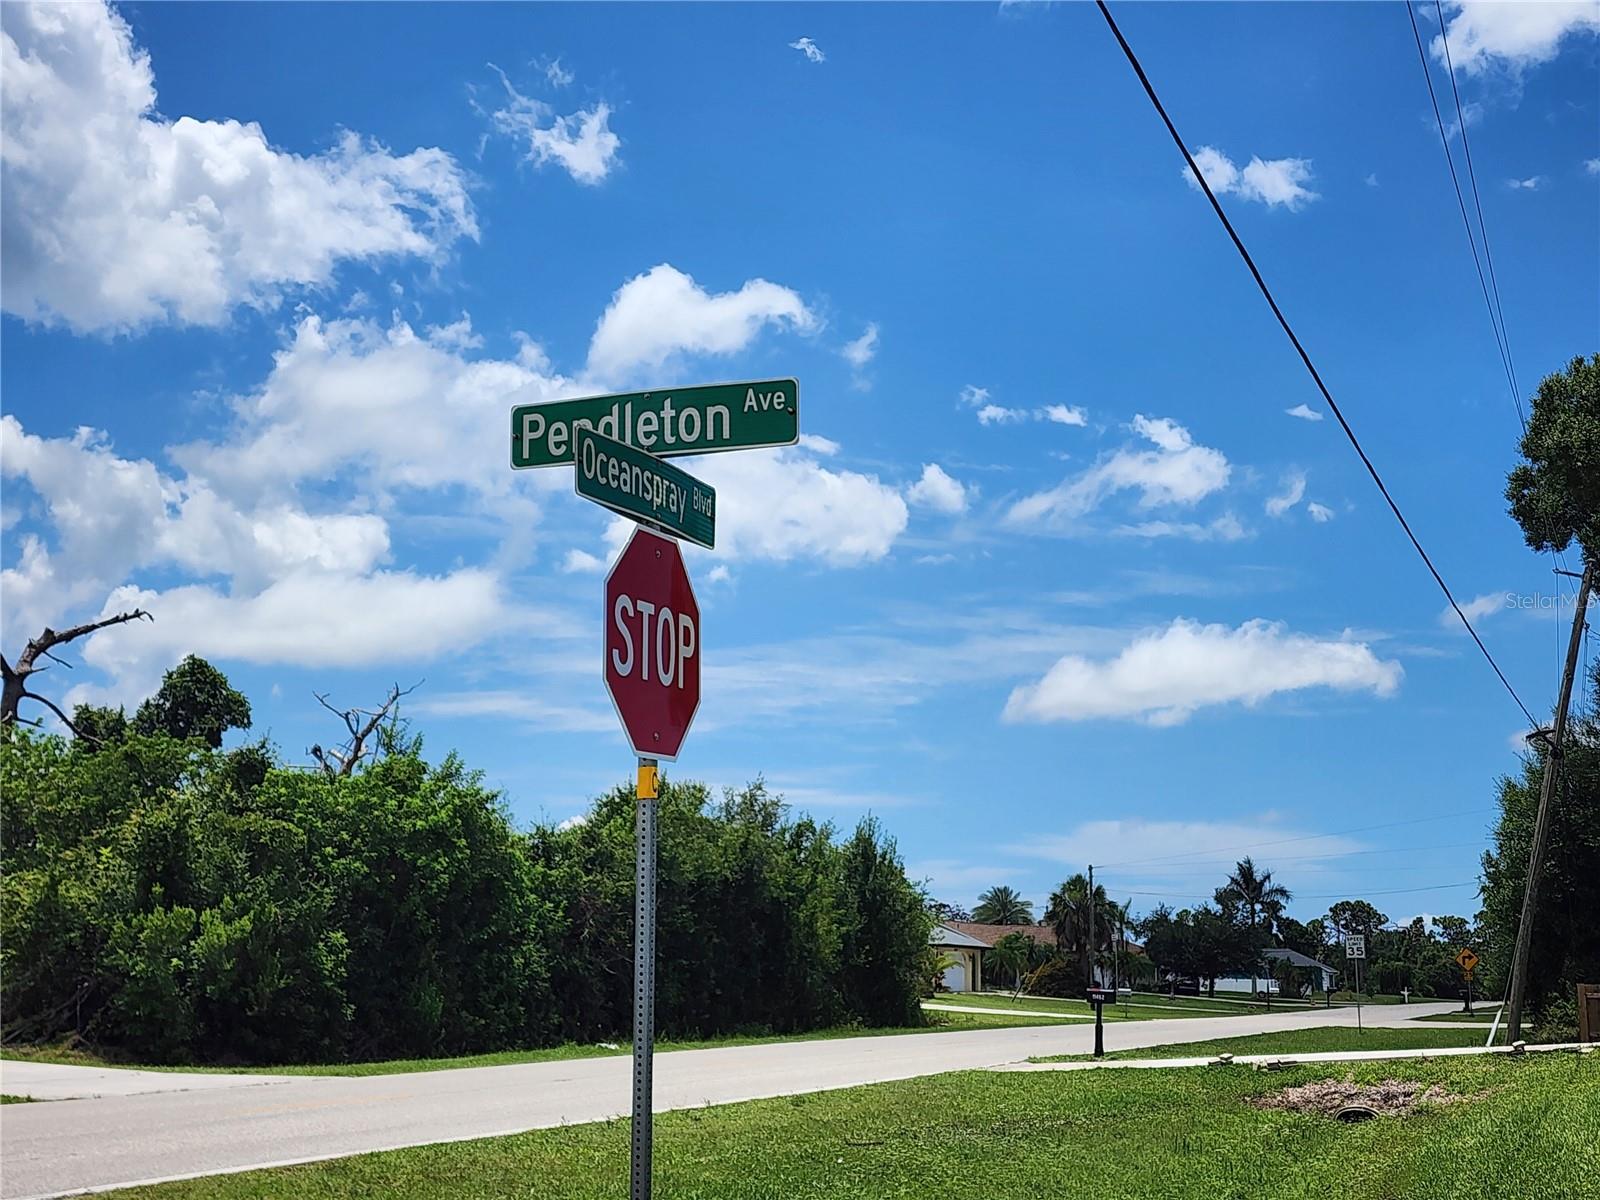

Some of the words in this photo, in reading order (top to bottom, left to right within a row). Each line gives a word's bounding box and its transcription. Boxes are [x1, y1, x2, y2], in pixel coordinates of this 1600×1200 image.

[744, 388, 785, 413] Ave
[582, 437, 687, 524] Oceanspray
[693, 487, 712, 517] Blvd
[612, 594, 696, 689] STOP
[1347, 946, 1364, 956] 35
